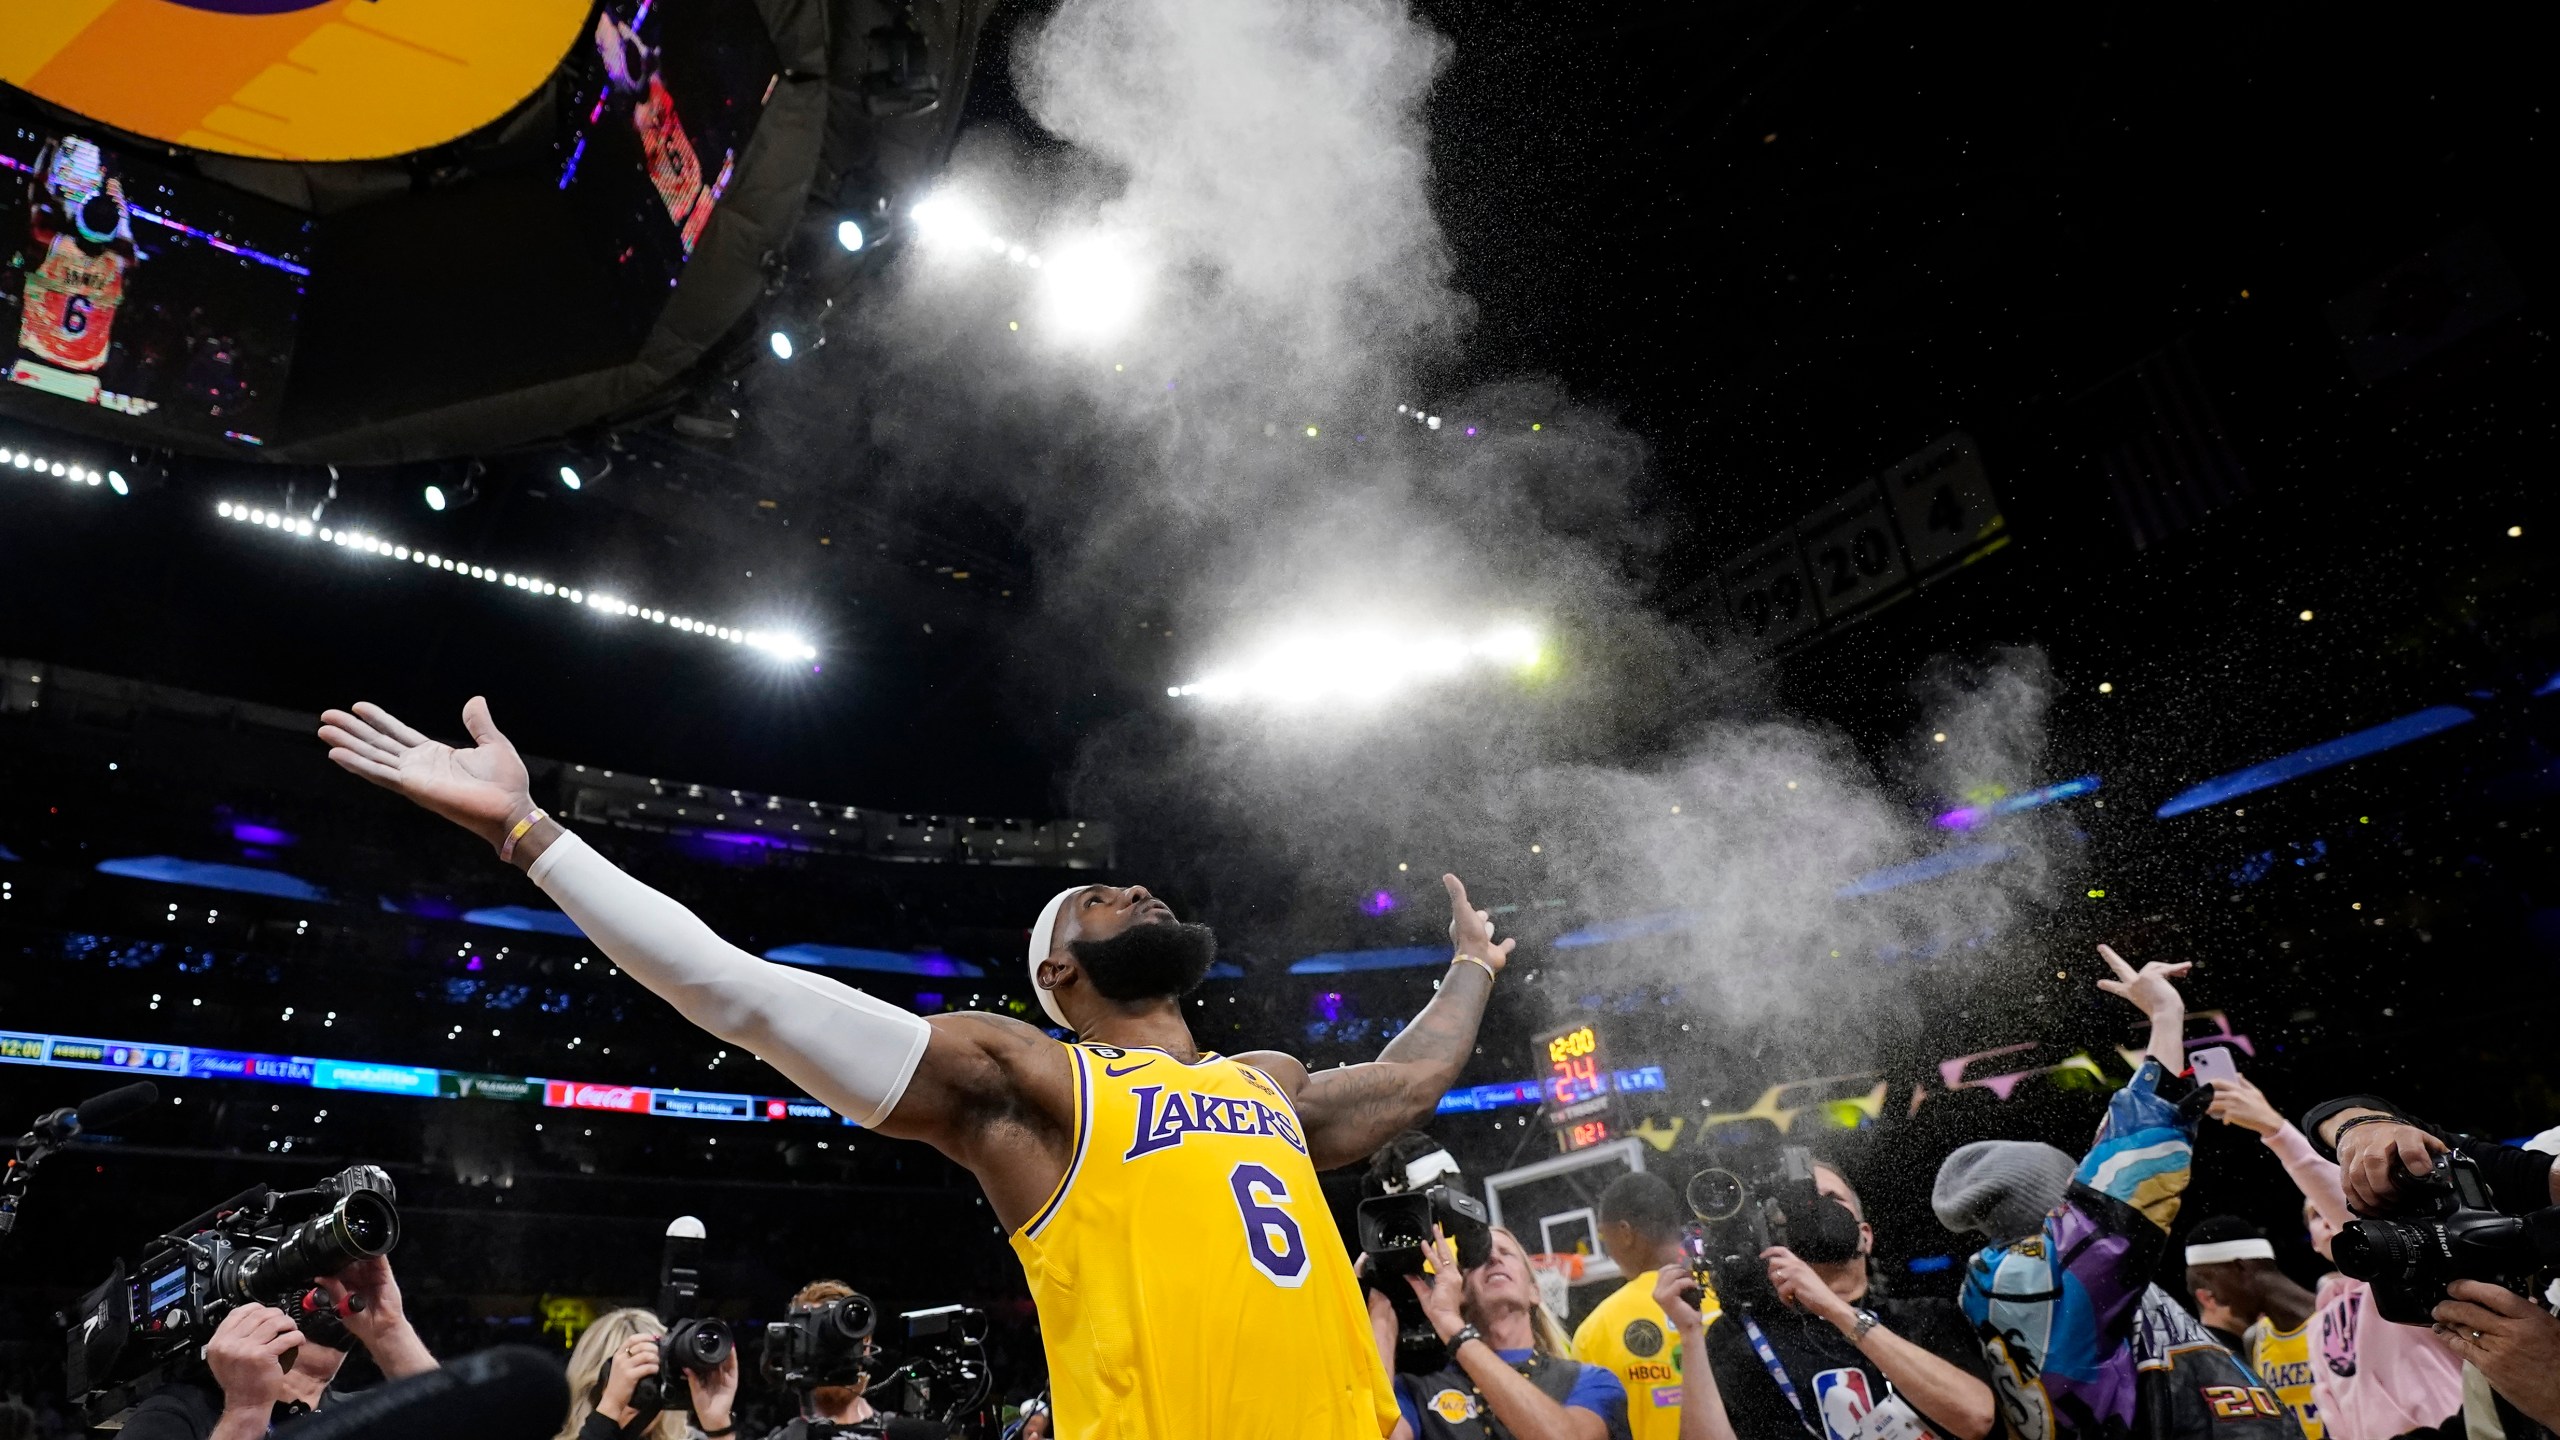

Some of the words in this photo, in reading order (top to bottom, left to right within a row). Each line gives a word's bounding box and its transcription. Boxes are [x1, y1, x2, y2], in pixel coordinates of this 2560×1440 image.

[62, 294, 93, 334] 6
[1818, 527, 1890, 597] 20
[113, 1048, 128, 1065] 0
[152, 1051, 166, 1068] 0
[1548, 1028, 1596, 1062] 12:00
[255, 1060, 311, 1080] ULTRA
[1553, 1056, 1598, 1102] 24
[787, 1104, 831, 1118] TOYOTA
[1122, 1083, 1308, 1164] LAKERS
[1228, 1161, 1312, 1288] 6
[2434, 1224, 2453, 1258] Nikon
[1628, 1365, 1672, 1381] HBCU
[2201, 1385, 2282, 1420] 20
